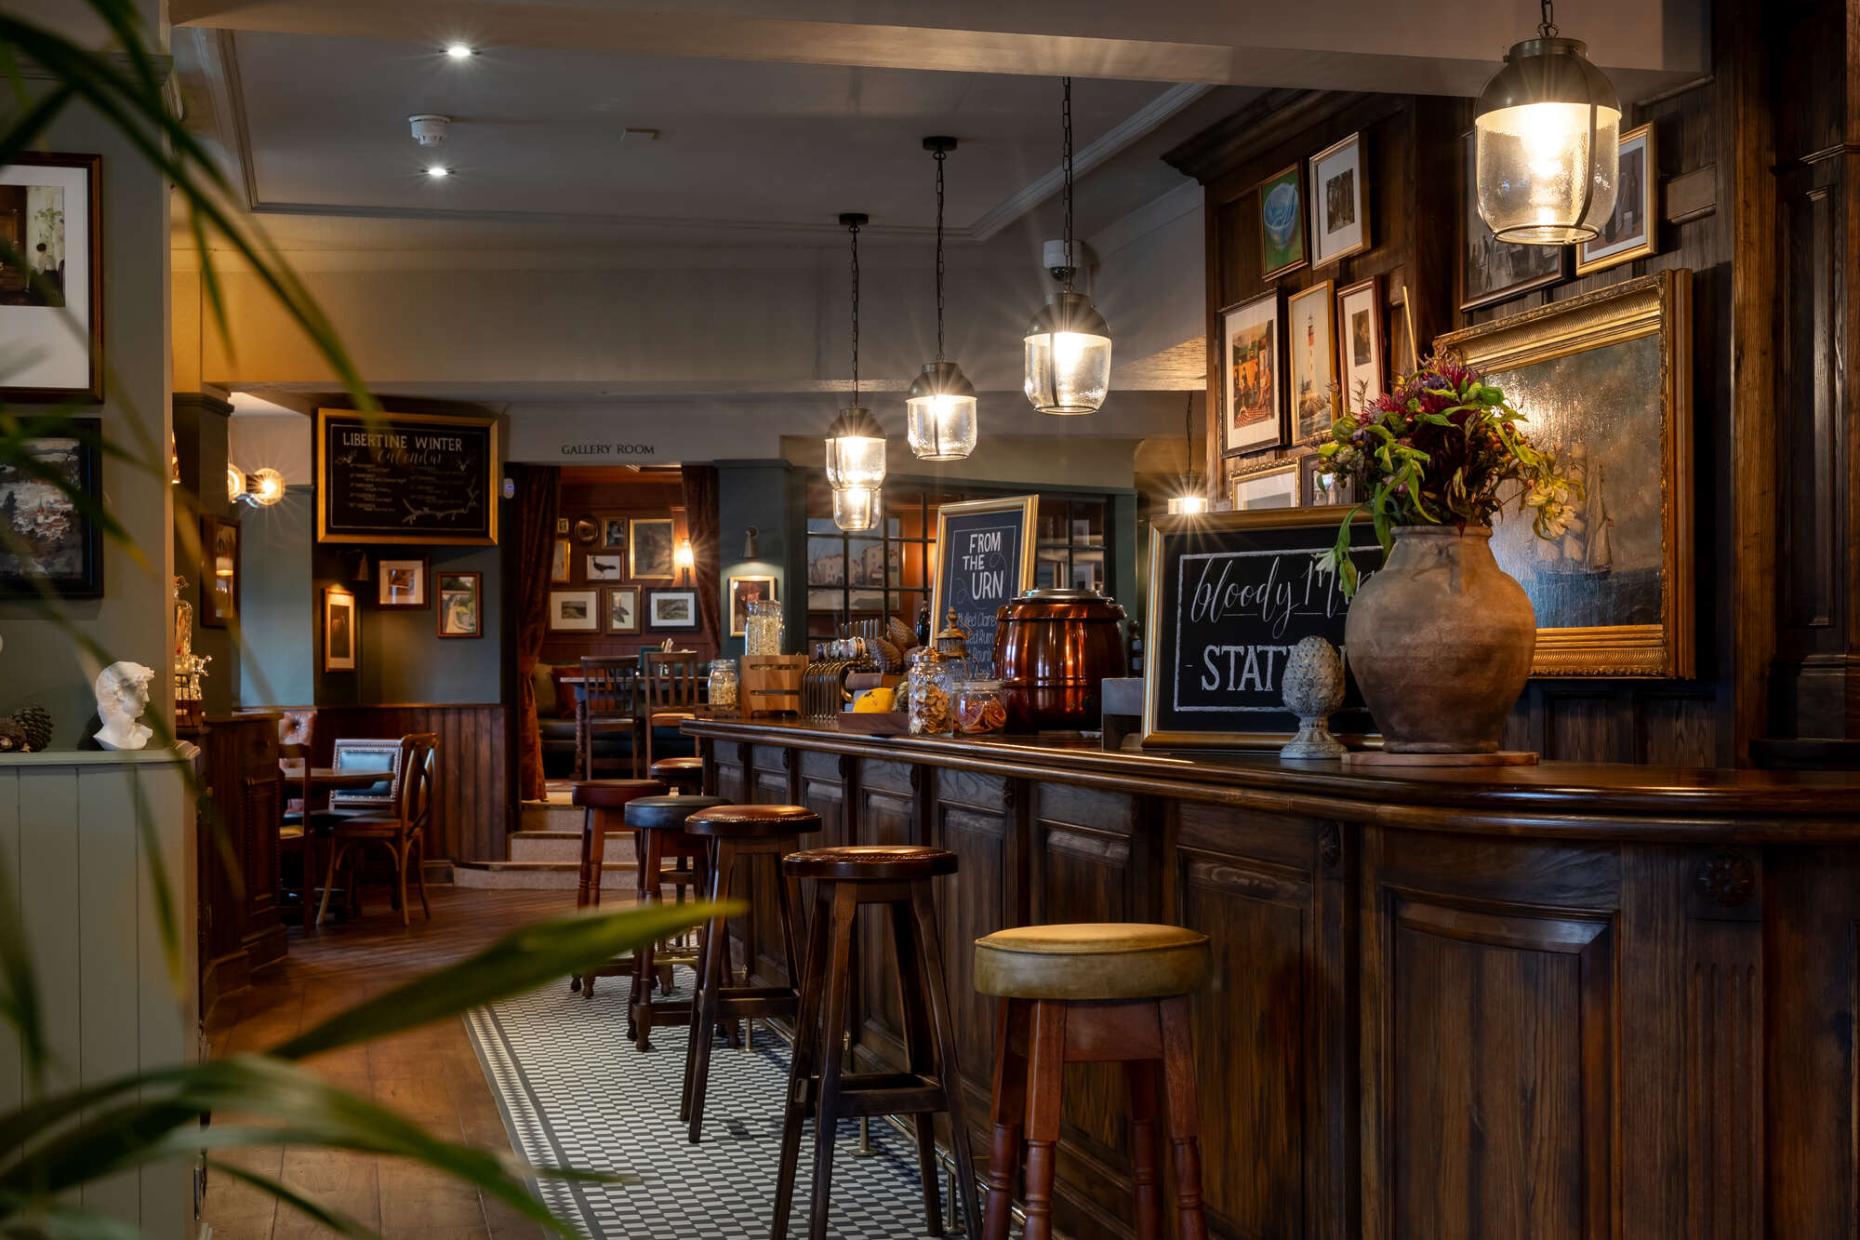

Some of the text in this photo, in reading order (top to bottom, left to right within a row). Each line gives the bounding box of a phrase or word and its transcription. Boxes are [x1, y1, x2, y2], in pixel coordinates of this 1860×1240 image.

[342, 432, 462, 452] LIBERTINE WINTER
[561, 444, 655, 455] GALLERY ROOM
[969, 531, 1001, 554] FROM
[962, 554, 985, 571] THE
[971, 570, 1004, 600] URN
[1190, 555, 1300, 639] bloody
